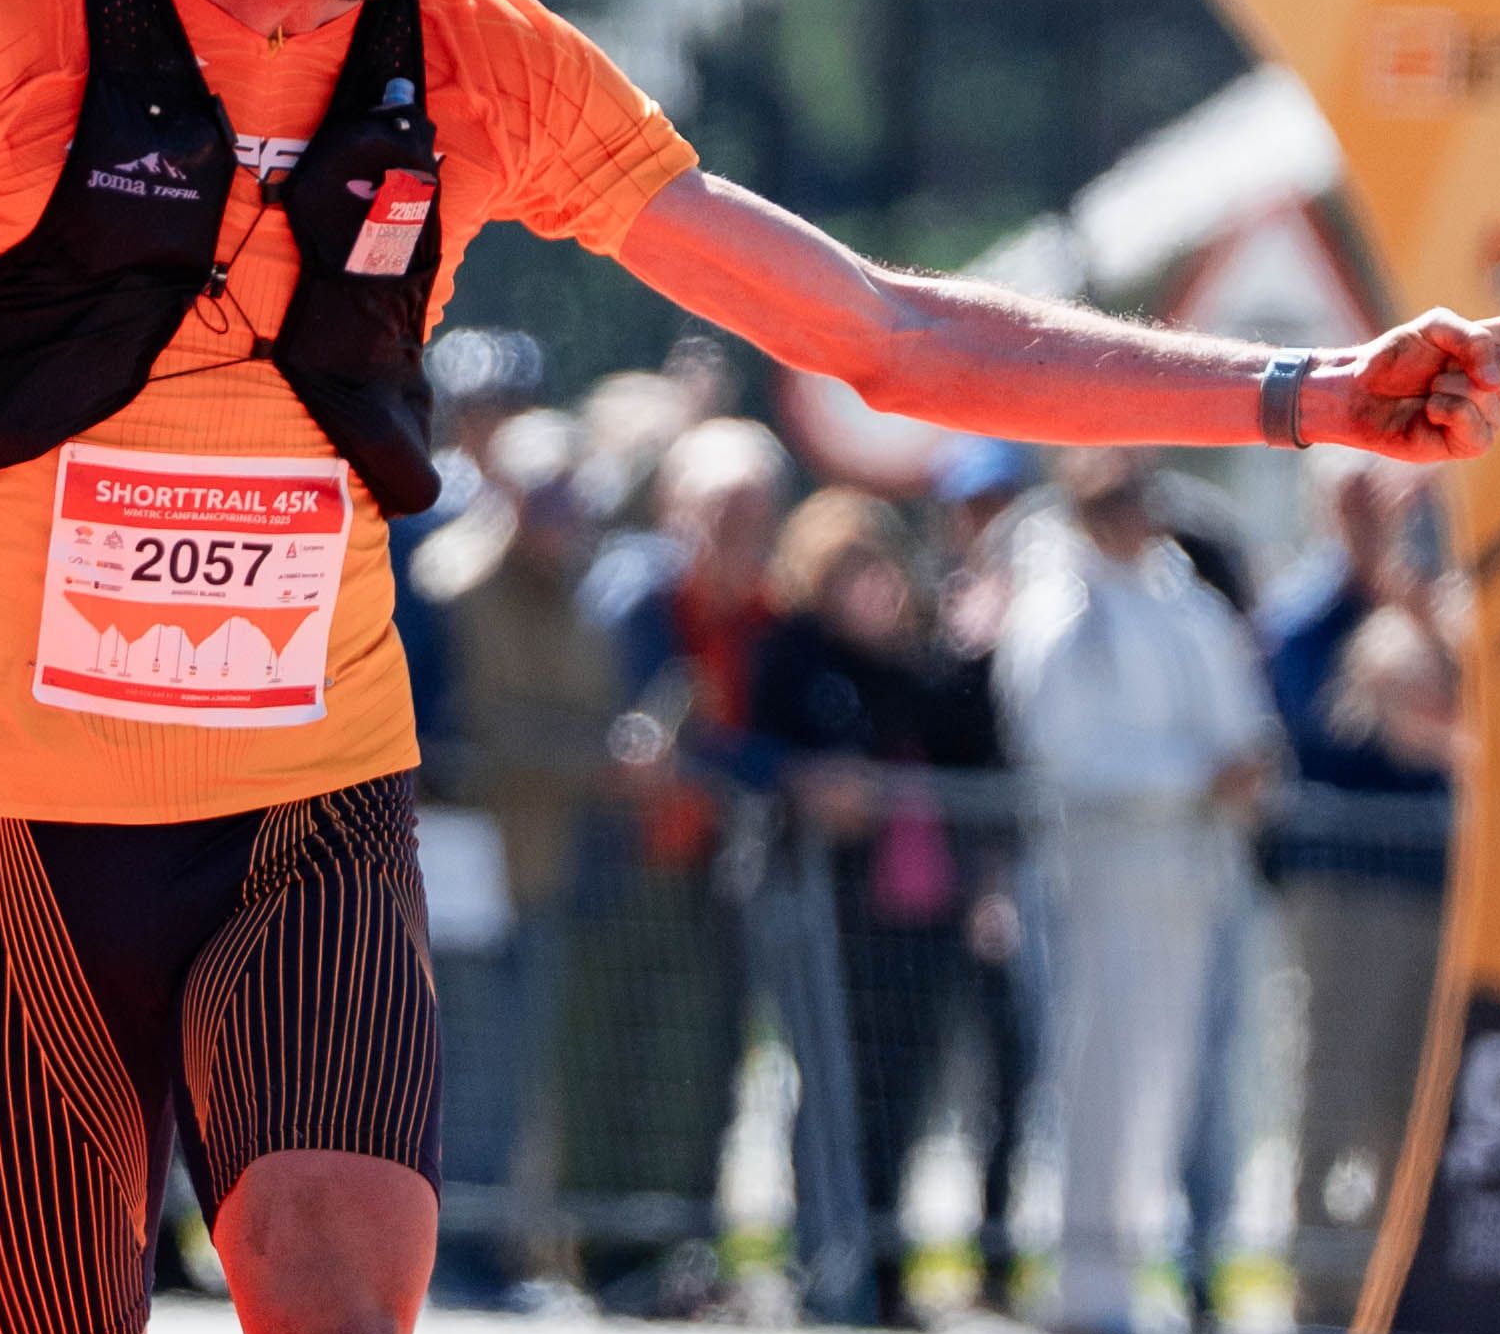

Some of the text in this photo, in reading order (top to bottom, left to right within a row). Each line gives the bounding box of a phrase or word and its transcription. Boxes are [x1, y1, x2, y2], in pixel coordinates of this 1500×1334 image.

[95, 479, 320, 514] SHORTTRAIL 45K
[123, 506, 162, 519] WMTRC
[131, 536, 273, 587] 2057
